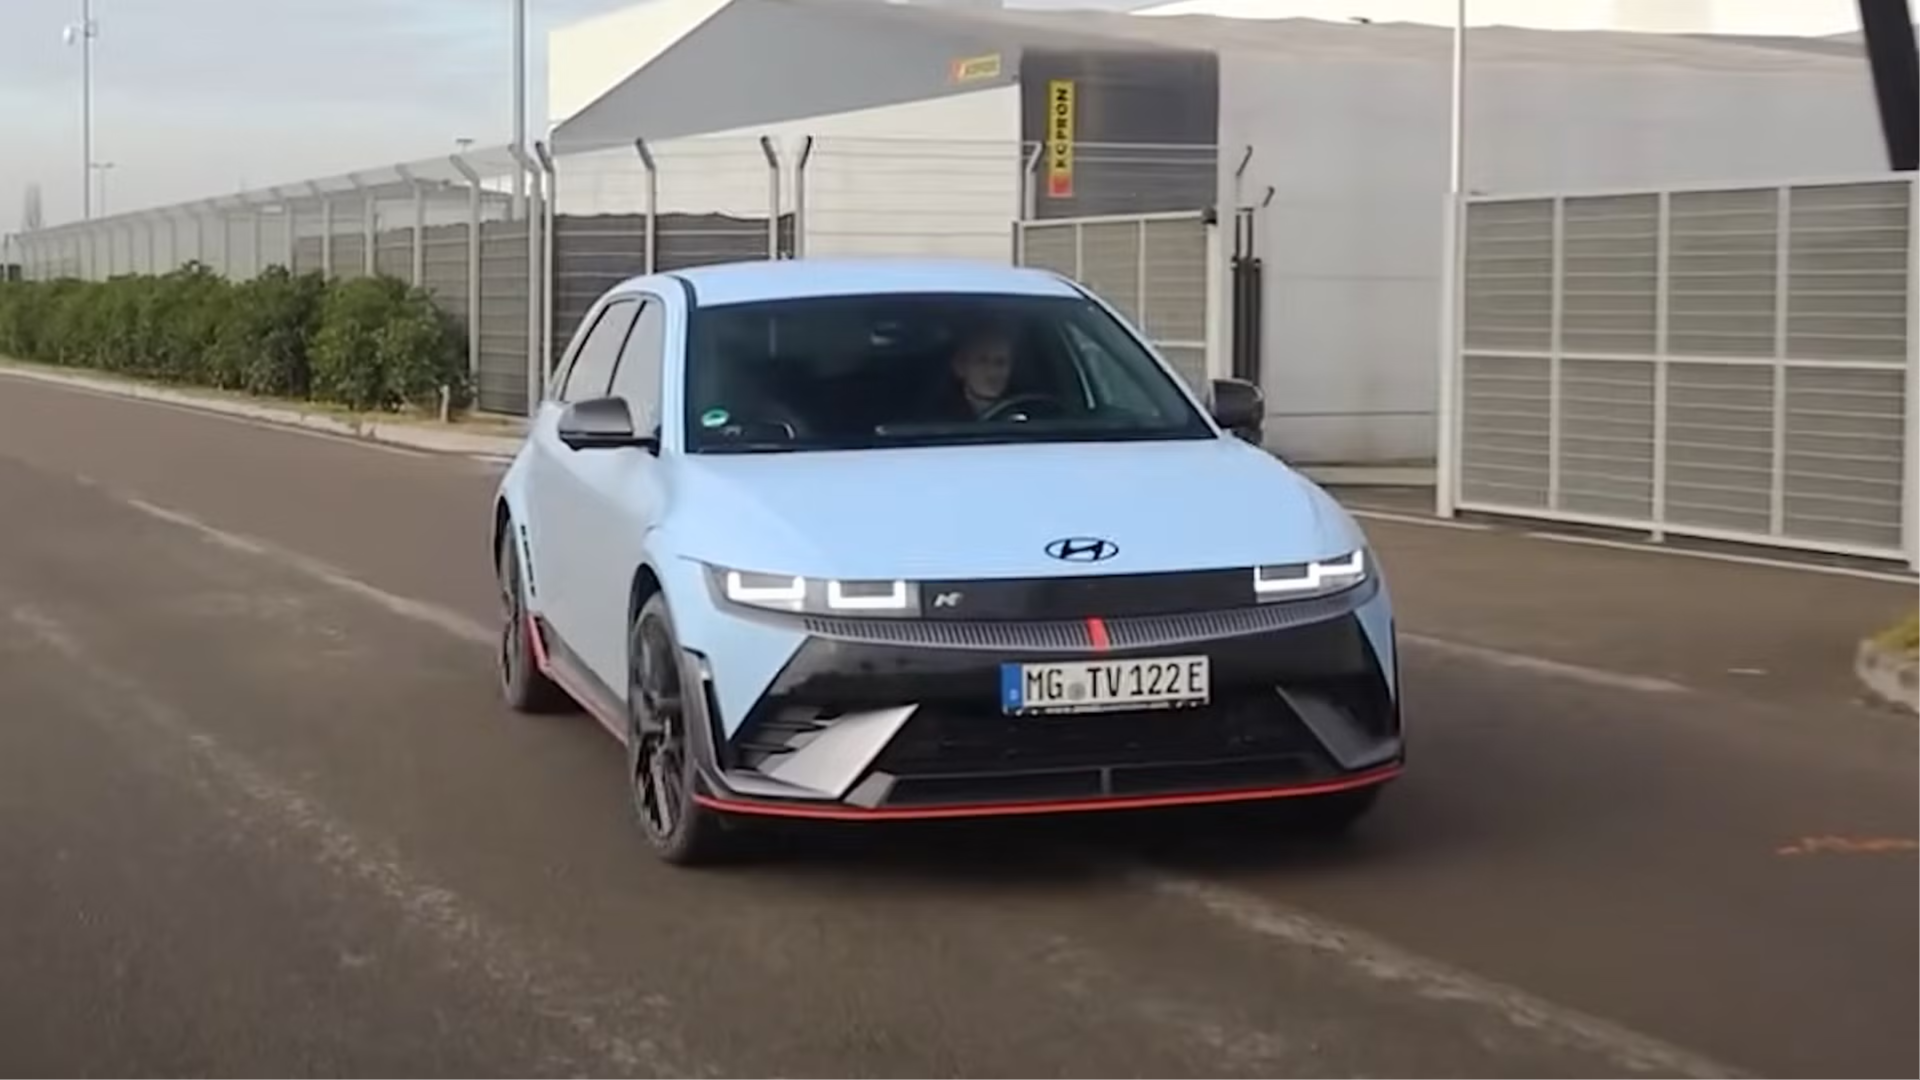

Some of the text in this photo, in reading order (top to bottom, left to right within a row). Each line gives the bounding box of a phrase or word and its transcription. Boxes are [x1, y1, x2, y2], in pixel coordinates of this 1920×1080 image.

[1055, 87, 1068, 169] KOPRON
[1026, 669, 1063, 701] MG
[1086, 667, 1121, 698] TV
